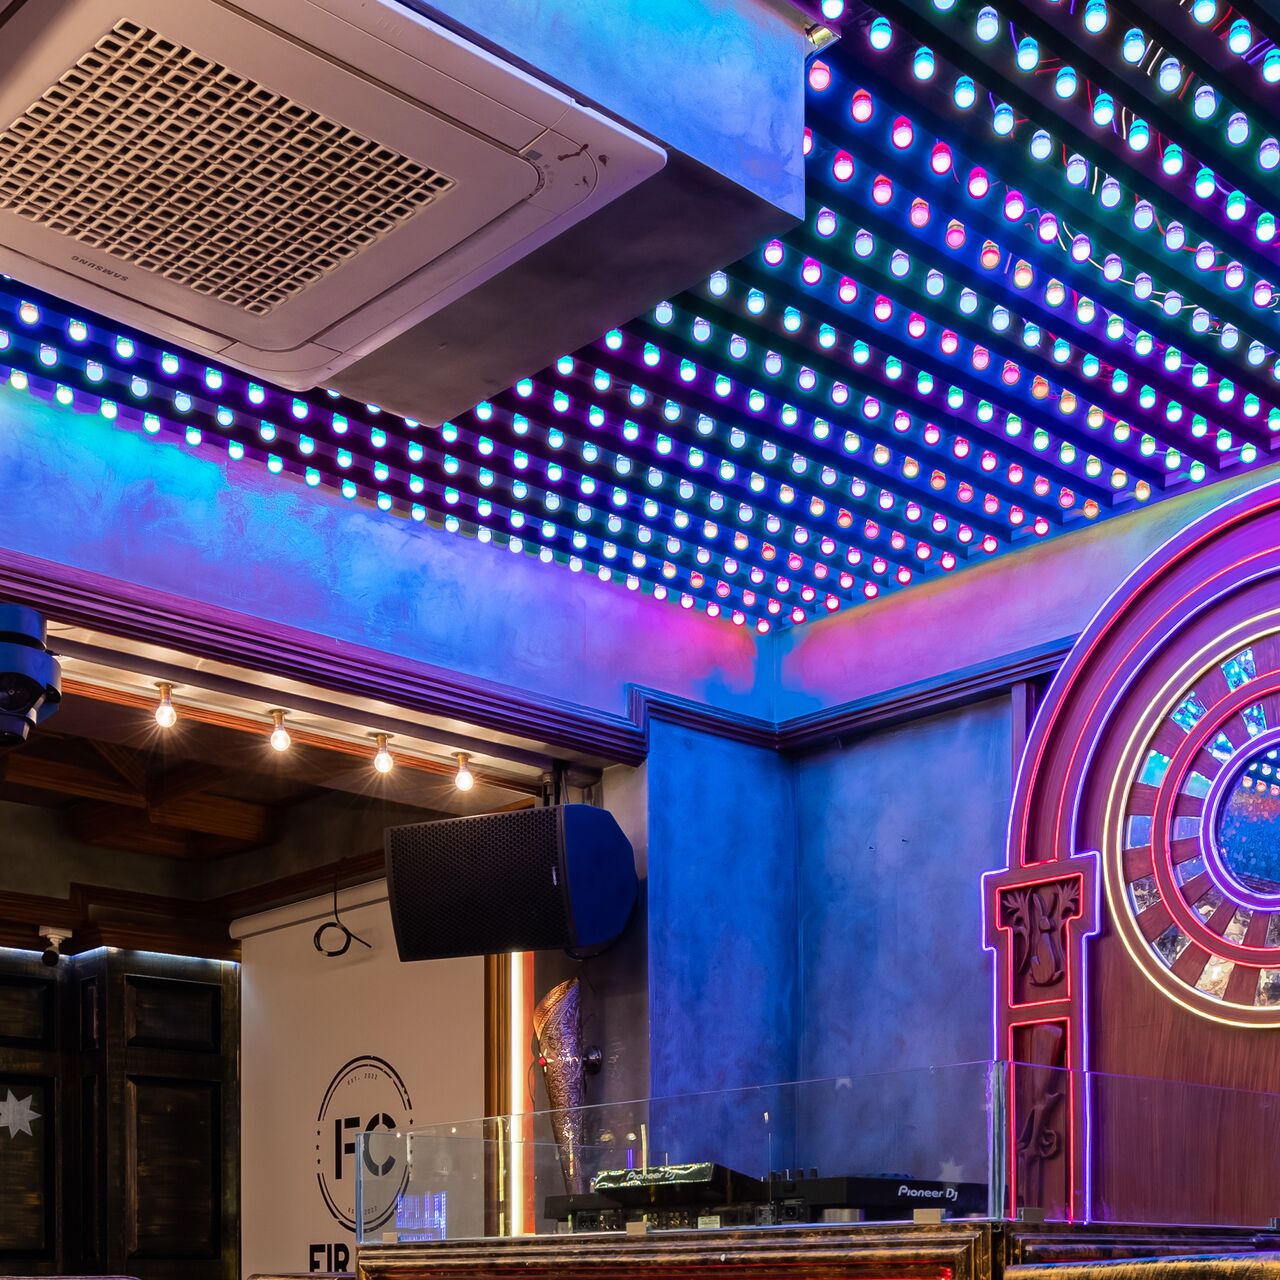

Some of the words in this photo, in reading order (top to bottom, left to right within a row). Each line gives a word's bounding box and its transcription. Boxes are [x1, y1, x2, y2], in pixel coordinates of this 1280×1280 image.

[71, 255, 129, 281] SAMSUNG
[335, 1112, 397, 1180] FC
[626, 1171, 665, 1181] Pioneer
[897, 1185, 944, 1198] Pioneer
